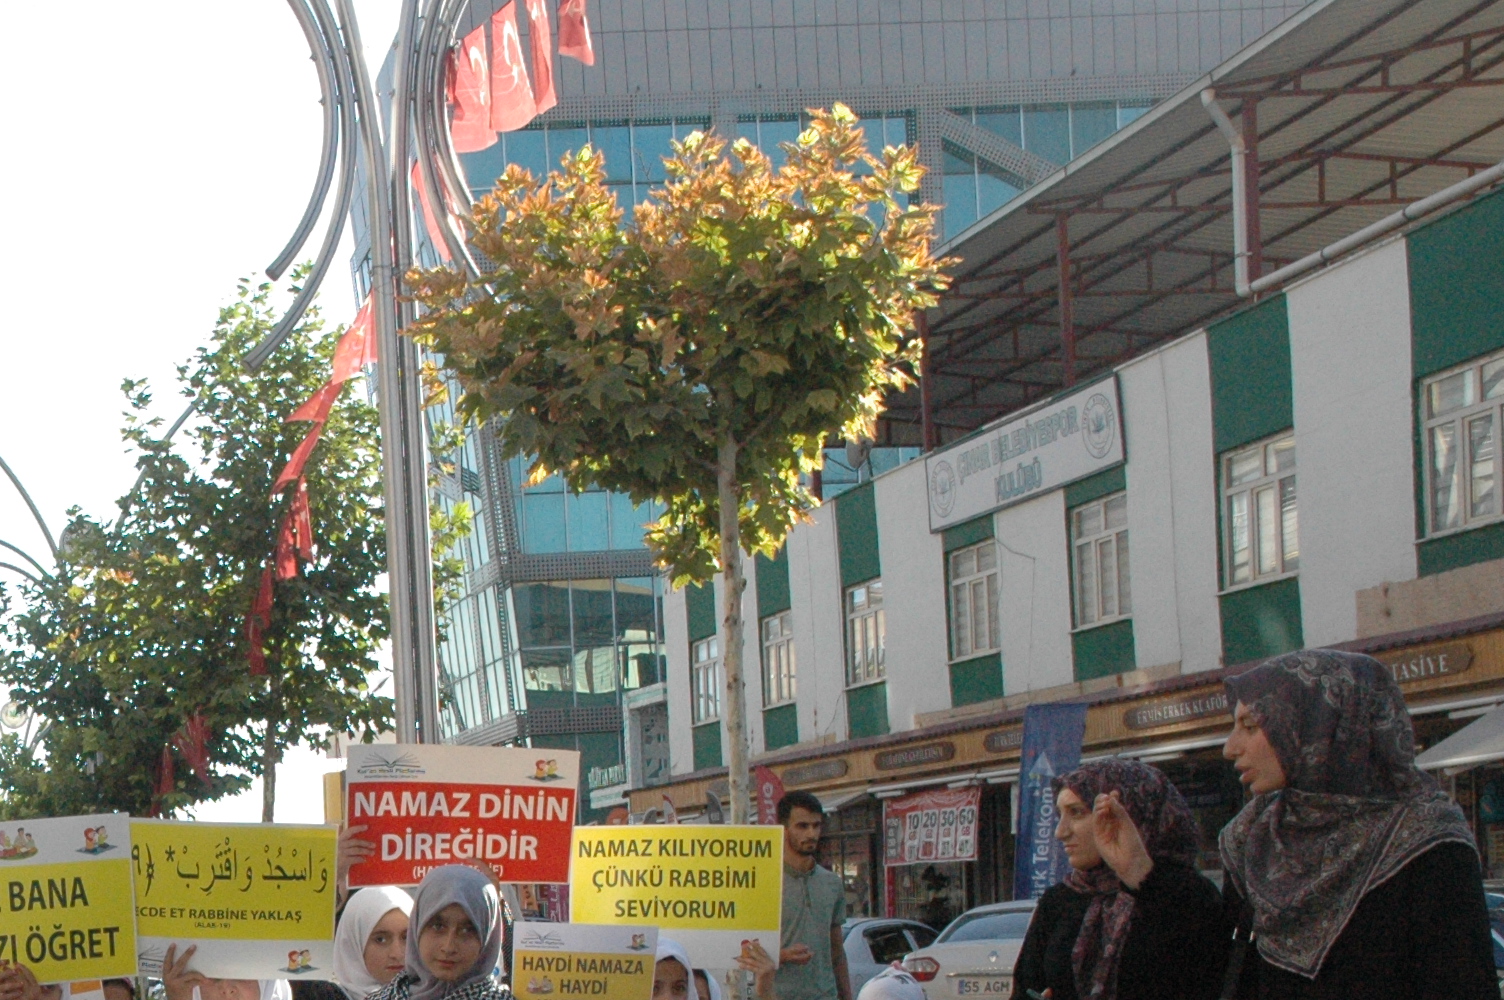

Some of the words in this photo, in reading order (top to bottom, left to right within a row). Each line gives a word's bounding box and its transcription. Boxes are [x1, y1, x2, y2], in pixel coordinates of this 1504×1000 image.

[1391, 653, 1449, 681] TASİYE
[354, 790, 471, 818] NAMAZ
[478, 787, 569, 822] DİNİN
[908, 814, 919, 830] 10
[924, 812, 937, 828] 20
[941, 810, 955, 826] 30
[959, 808, 975, 825] 60
[1032, 786, 1053, 865] Telekom
[381, 827, 538, 862] DİREĞİDİR
[578, 839, 653, 858] NAMAZ
[658, 838, 772, 858] KILIYORUM
[592, 865, 664, 893] ÇÜNKÜ
[669, 865, 756, 889] RABBİMİ
[8, 876, 89, 912] BANA
[614, 895, 736, 919] SEVİYORUM
[170, 908, 186, 919] ET
[188, 907, 247, 920] RABBİNE
[251, 909, 302, 923] YAKLAŞ
[25, 923, 120, 964] ÖĞRET
[522, 954, 572, 972] HAYDİ
[575, 958, 644, 975] NAMAZA
[559, 976, 607, 994] HAYDİ
